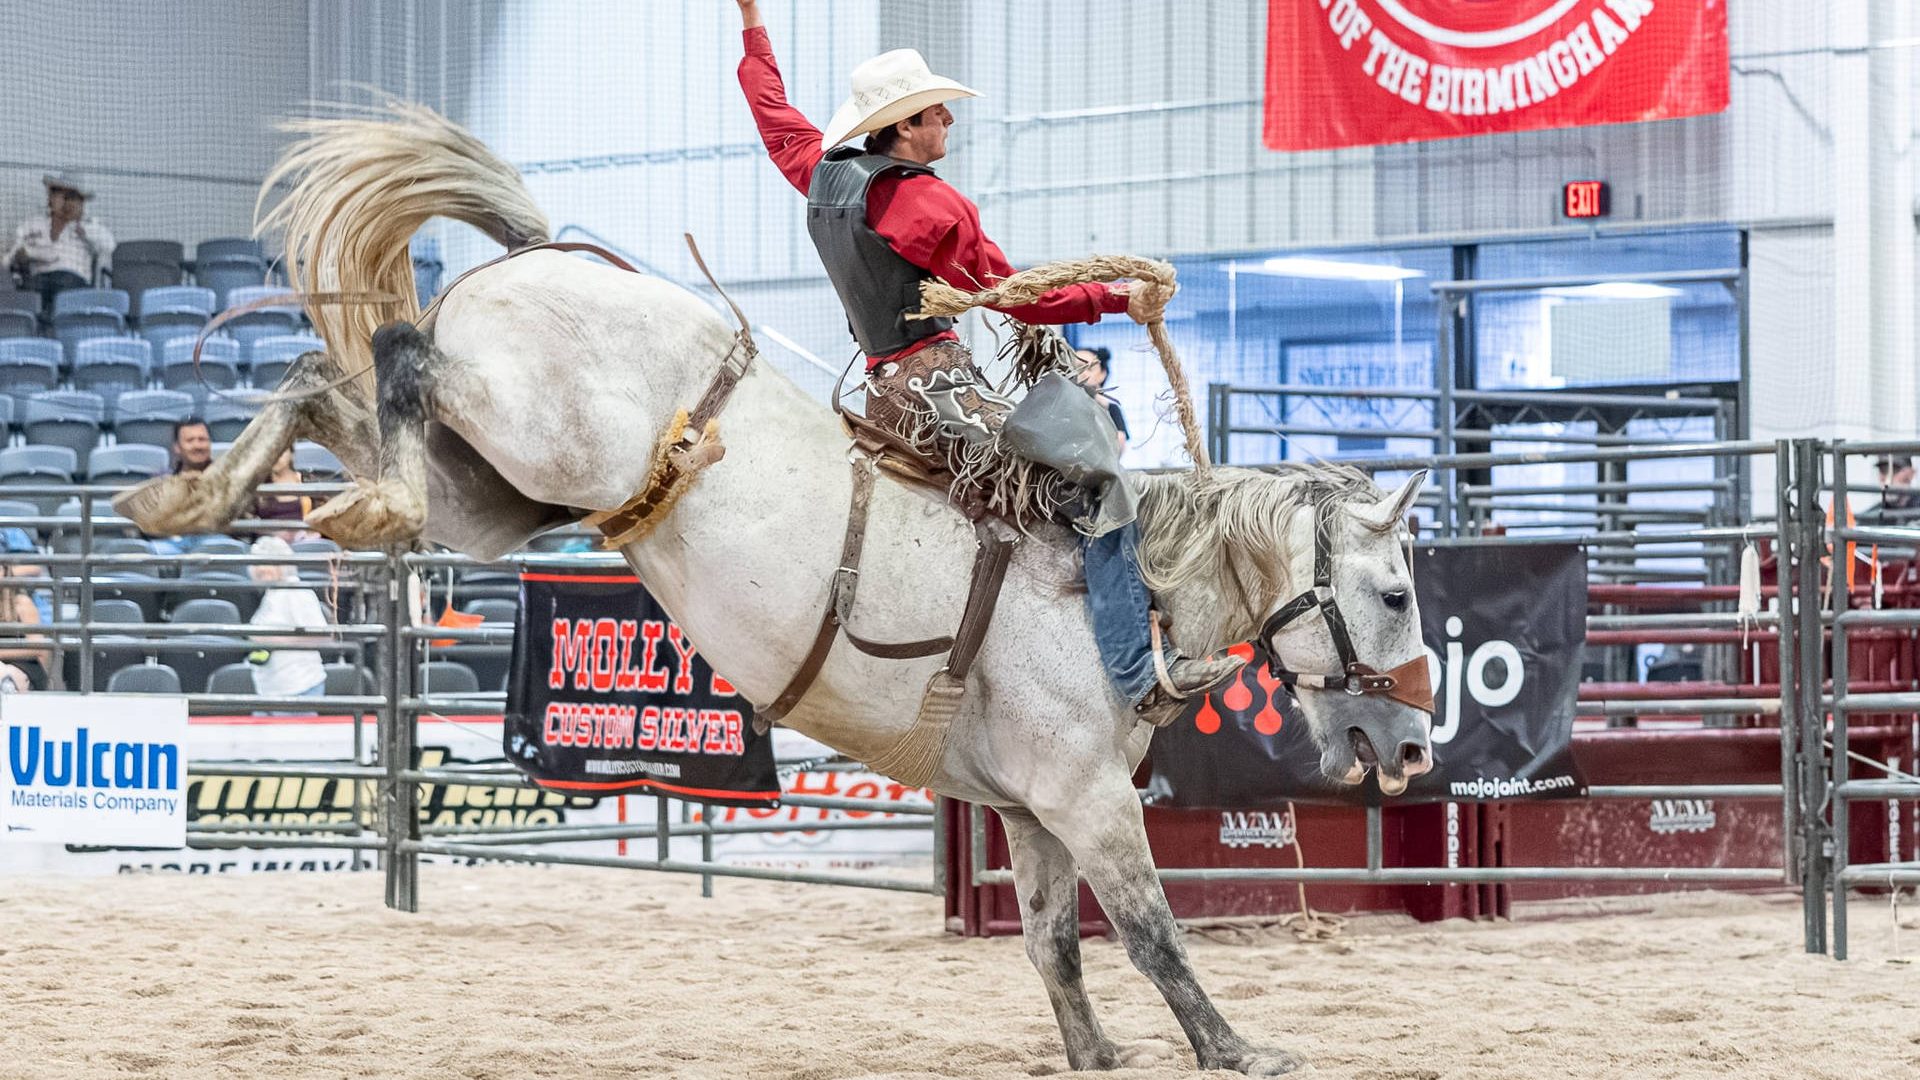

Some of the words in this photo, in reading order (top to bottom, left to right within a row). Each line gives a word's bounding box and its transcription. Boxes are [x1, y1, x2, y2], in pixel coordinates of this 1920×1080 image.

[1329, 0, 1372, 50] OF
[1362, 28, 1429, 105] THE
[1425, 0, 1655, 116] BIRMINGHAM
[1567, 182, 1601, 217] EXIT
[549, 618, 738, 697] MOLLY
[9, 726, 178, 790] Vulcan
[543, 702, 637, 749] CUSTOM
[638, 704, 745, 756] SILVER
[11, 790, 88, 809] Materials
[93, 791, 178, 815] Company
[1450, 774, 1575, 798] mojojoint.com
[1447, 802, 1460, 869] RODE
